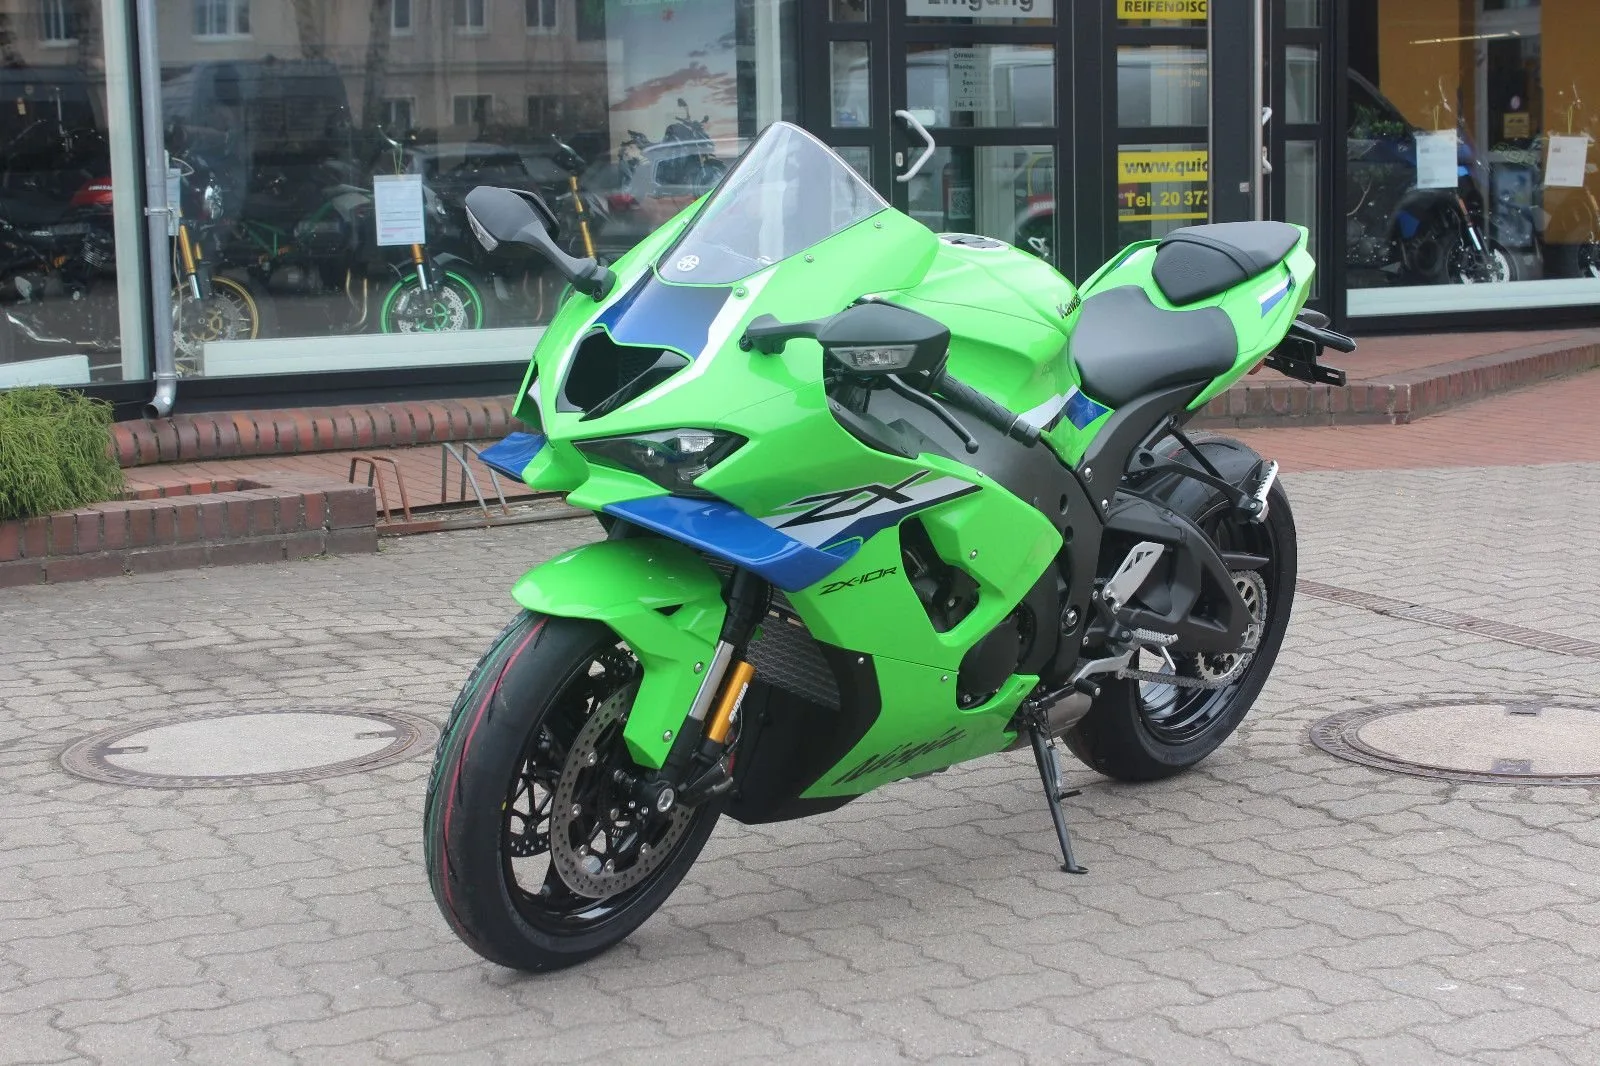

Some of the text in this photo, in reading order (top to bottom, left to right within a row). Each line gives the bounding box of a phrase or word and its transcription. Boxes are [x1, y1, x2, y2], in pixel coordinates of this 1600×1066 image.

[1124, 1, 1208, 13] REIFENDISC
[1124, 158, 1208, 176] www.quic
[1124, 191, 1156, 208] Tel.
[1160, 191, 1180, 207] 20
[1056, 291, 1082, 320] Kawa
[775, 469, 930, 529] ZX
[819, 566, 897, 596] ZX-10R
[831, 726, 967, 787] Ninja
